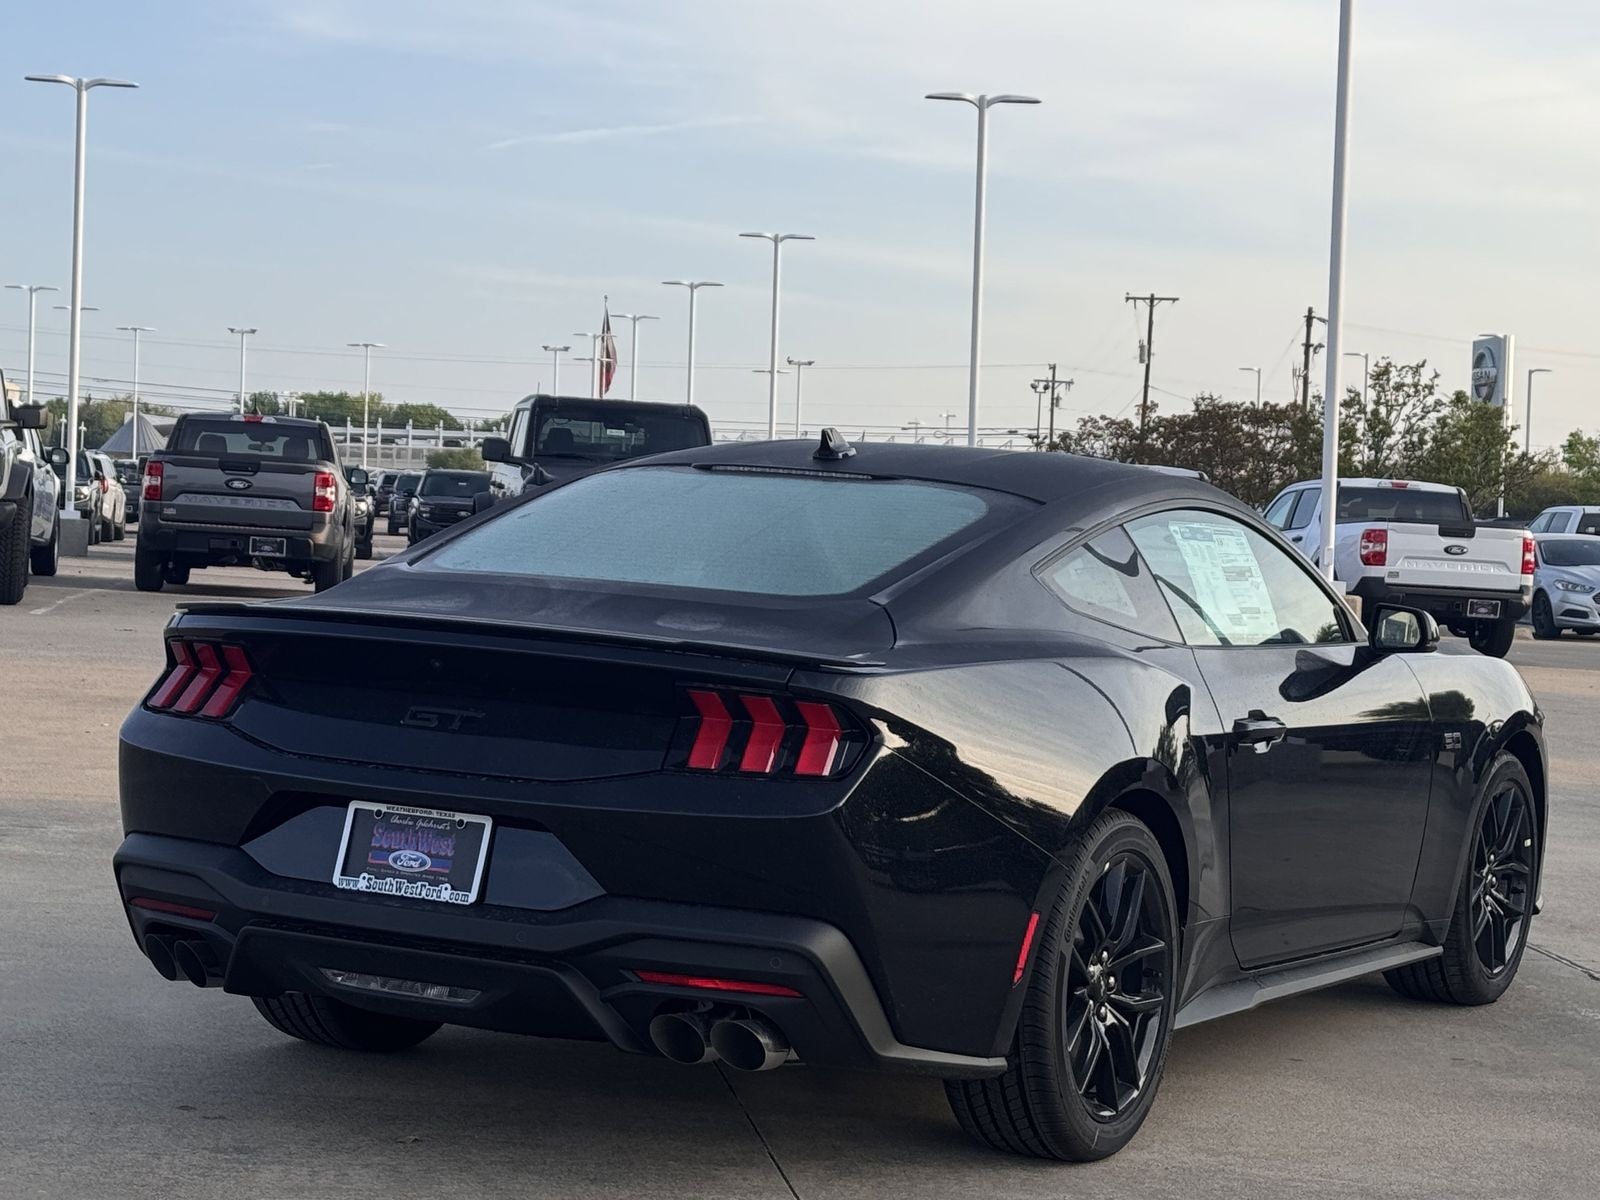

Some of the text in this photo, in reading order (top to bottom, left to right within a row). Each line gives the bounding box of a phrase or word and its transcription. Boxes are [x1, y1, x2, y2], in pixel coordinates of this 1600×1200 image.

[1404, 561, 1502, 572] MAVERICK
[400, 705, 487, 731] GT
[396, 853, 421, 868] Ford
